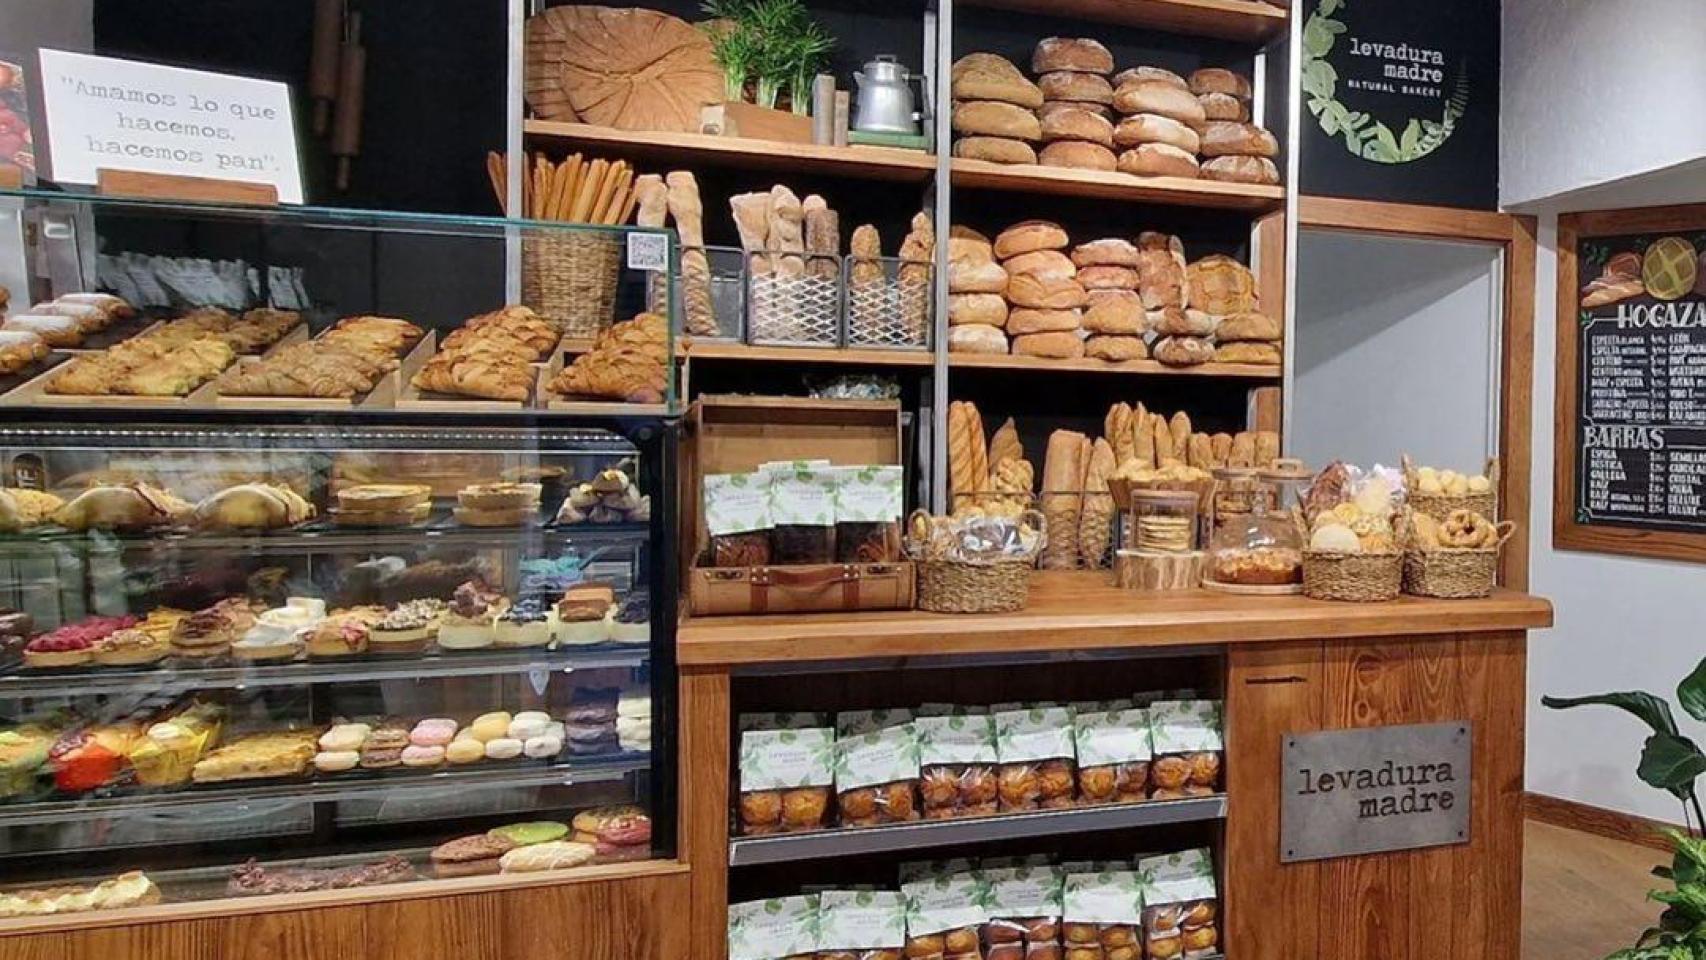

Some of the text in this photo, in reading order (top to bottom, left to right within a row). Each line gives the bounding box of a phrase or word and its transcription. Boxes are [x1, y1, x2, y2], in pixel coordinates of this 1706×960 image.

[1350, 38, 1444, 65] levadura
[1384, 63, 1443, 83] madre
[1348, 80, 1441, 98] NATURAL BAKERY
[189, 95, 219, 113] lo
[230, 103, 276, 121] que
[86, 135, 204, 164] hacemos
[1584, 426, 1665, 450] BARRAS
[1298, 761, 1455, 795] levadura
[1358, 788, 1455, 819] madre
